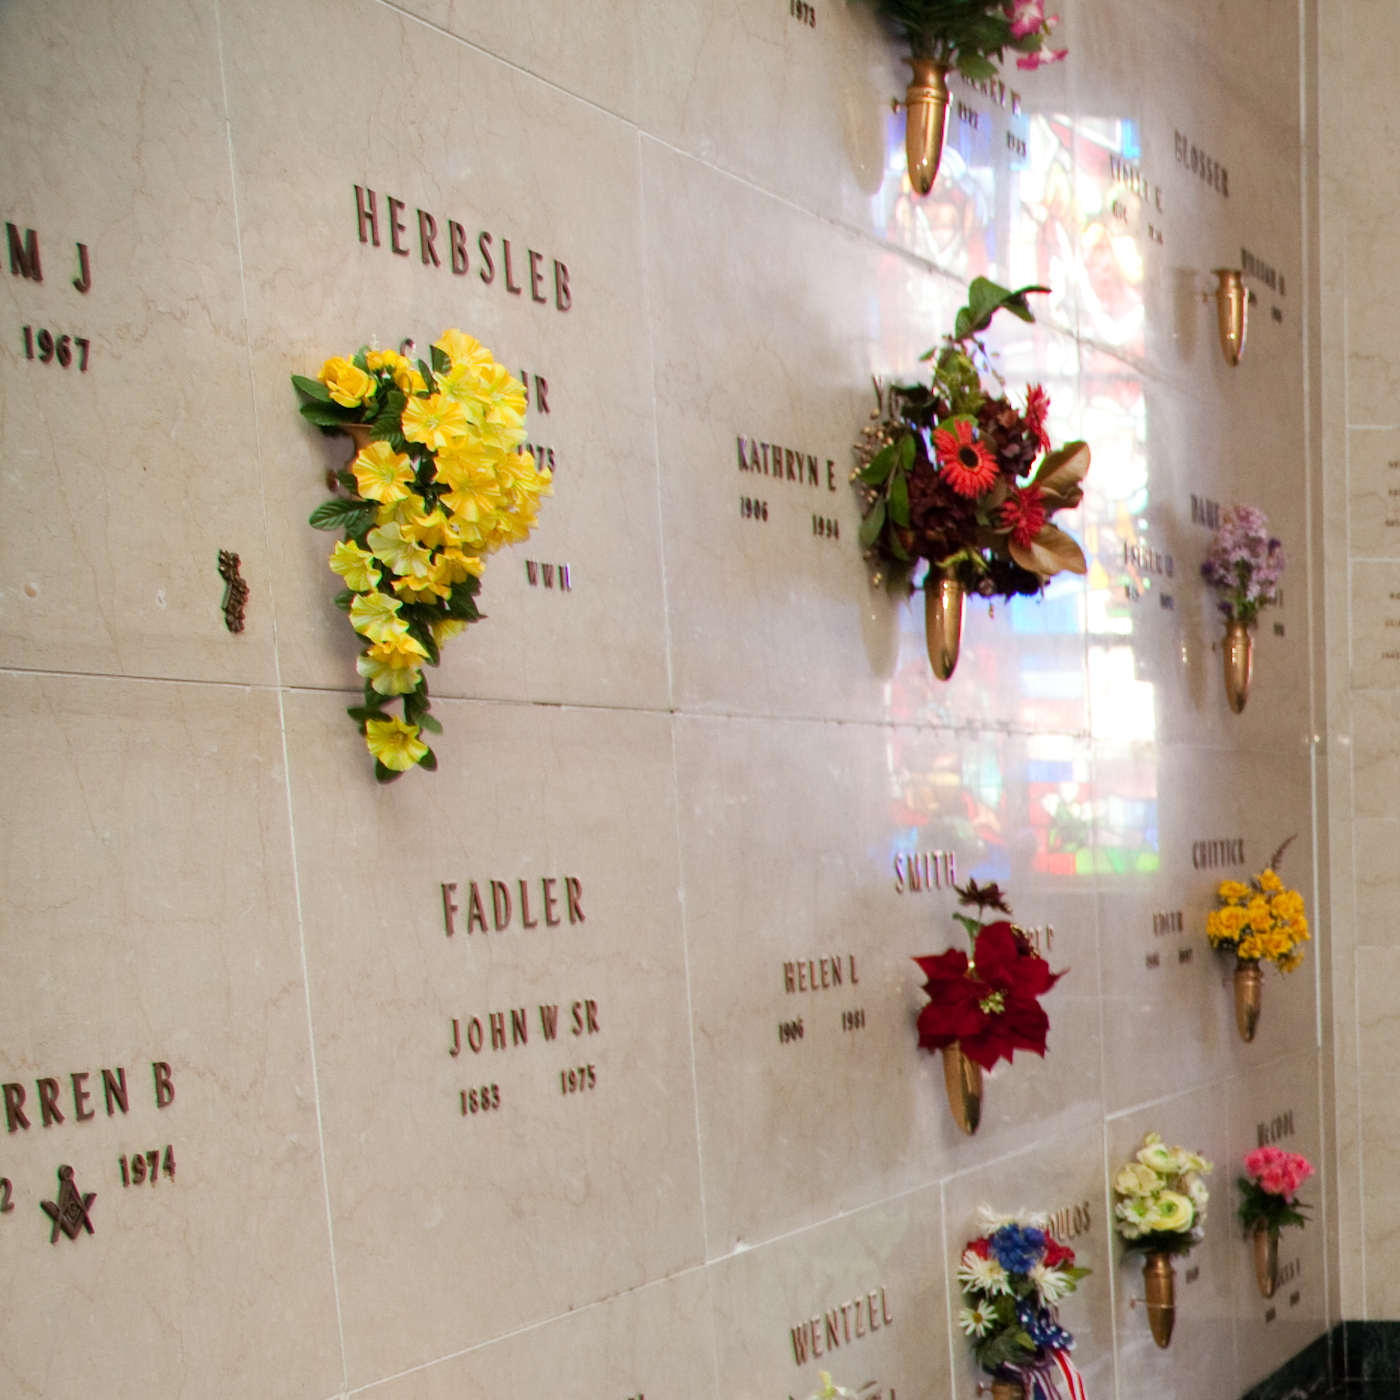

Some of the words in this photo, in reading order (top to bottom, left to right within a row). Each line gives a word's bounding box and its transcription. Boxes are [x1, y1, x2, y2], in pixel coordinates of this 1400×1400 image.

[353, 184, 573, 313] HERBSLEB
[22, 325, 90, 372] 1967
[737, 432, 820, 489] KATHRYN
[826, 459, 838, 493] E
[894, 851, 956, 895] SMITH
[441, 876, 587, 937] FADLER
[783, 955, 843, 995] HELEN
[849, 954, 860, 986] L
[448, 1008, 528, 1057] JOHN
[540, 1004, 559, 1041] W
[571, 1000, 601, 1036] SR
[152, 1061, 176, 1108] B
[560, 1065, 597, 1095] 1975
[119, 1145, 177, 1188] 1974
[791, 1284, 893, 1367] WENTZEL
